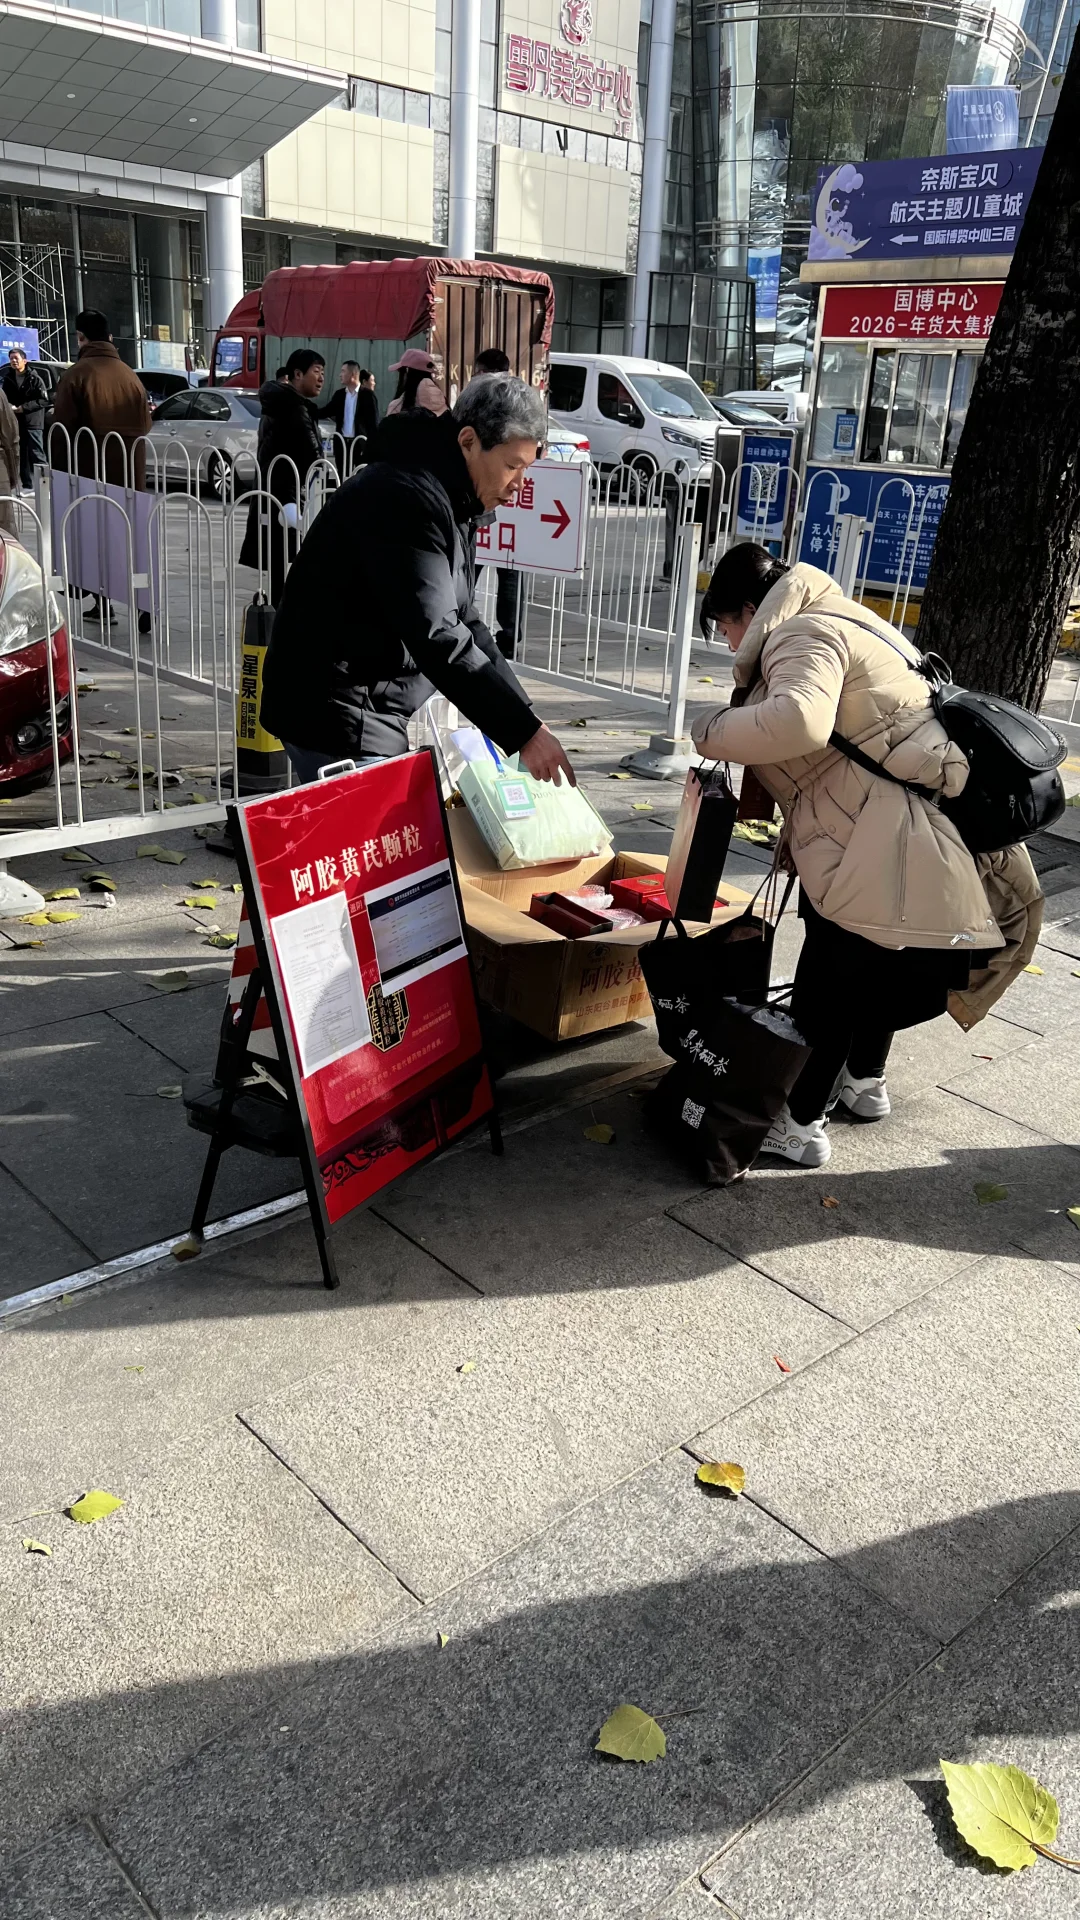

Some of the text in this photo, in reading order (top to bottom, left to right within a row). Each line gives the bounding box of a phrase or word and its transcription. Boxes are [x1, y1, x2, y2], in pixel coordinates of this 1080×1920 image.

[920, 163, 999, 192] 奈斯宝贝
[889, 192, 1024, 224] 航天主题儿童城
[923, 226, 1016, 246] 国际博览中心三层
[893, 288, 979, 313] 国博中心
[824, 482, 851, 516] P
[241, 654, 259, 700] 星泉
[290, 823, 423, 902] 阿胶黄芪颗粒
